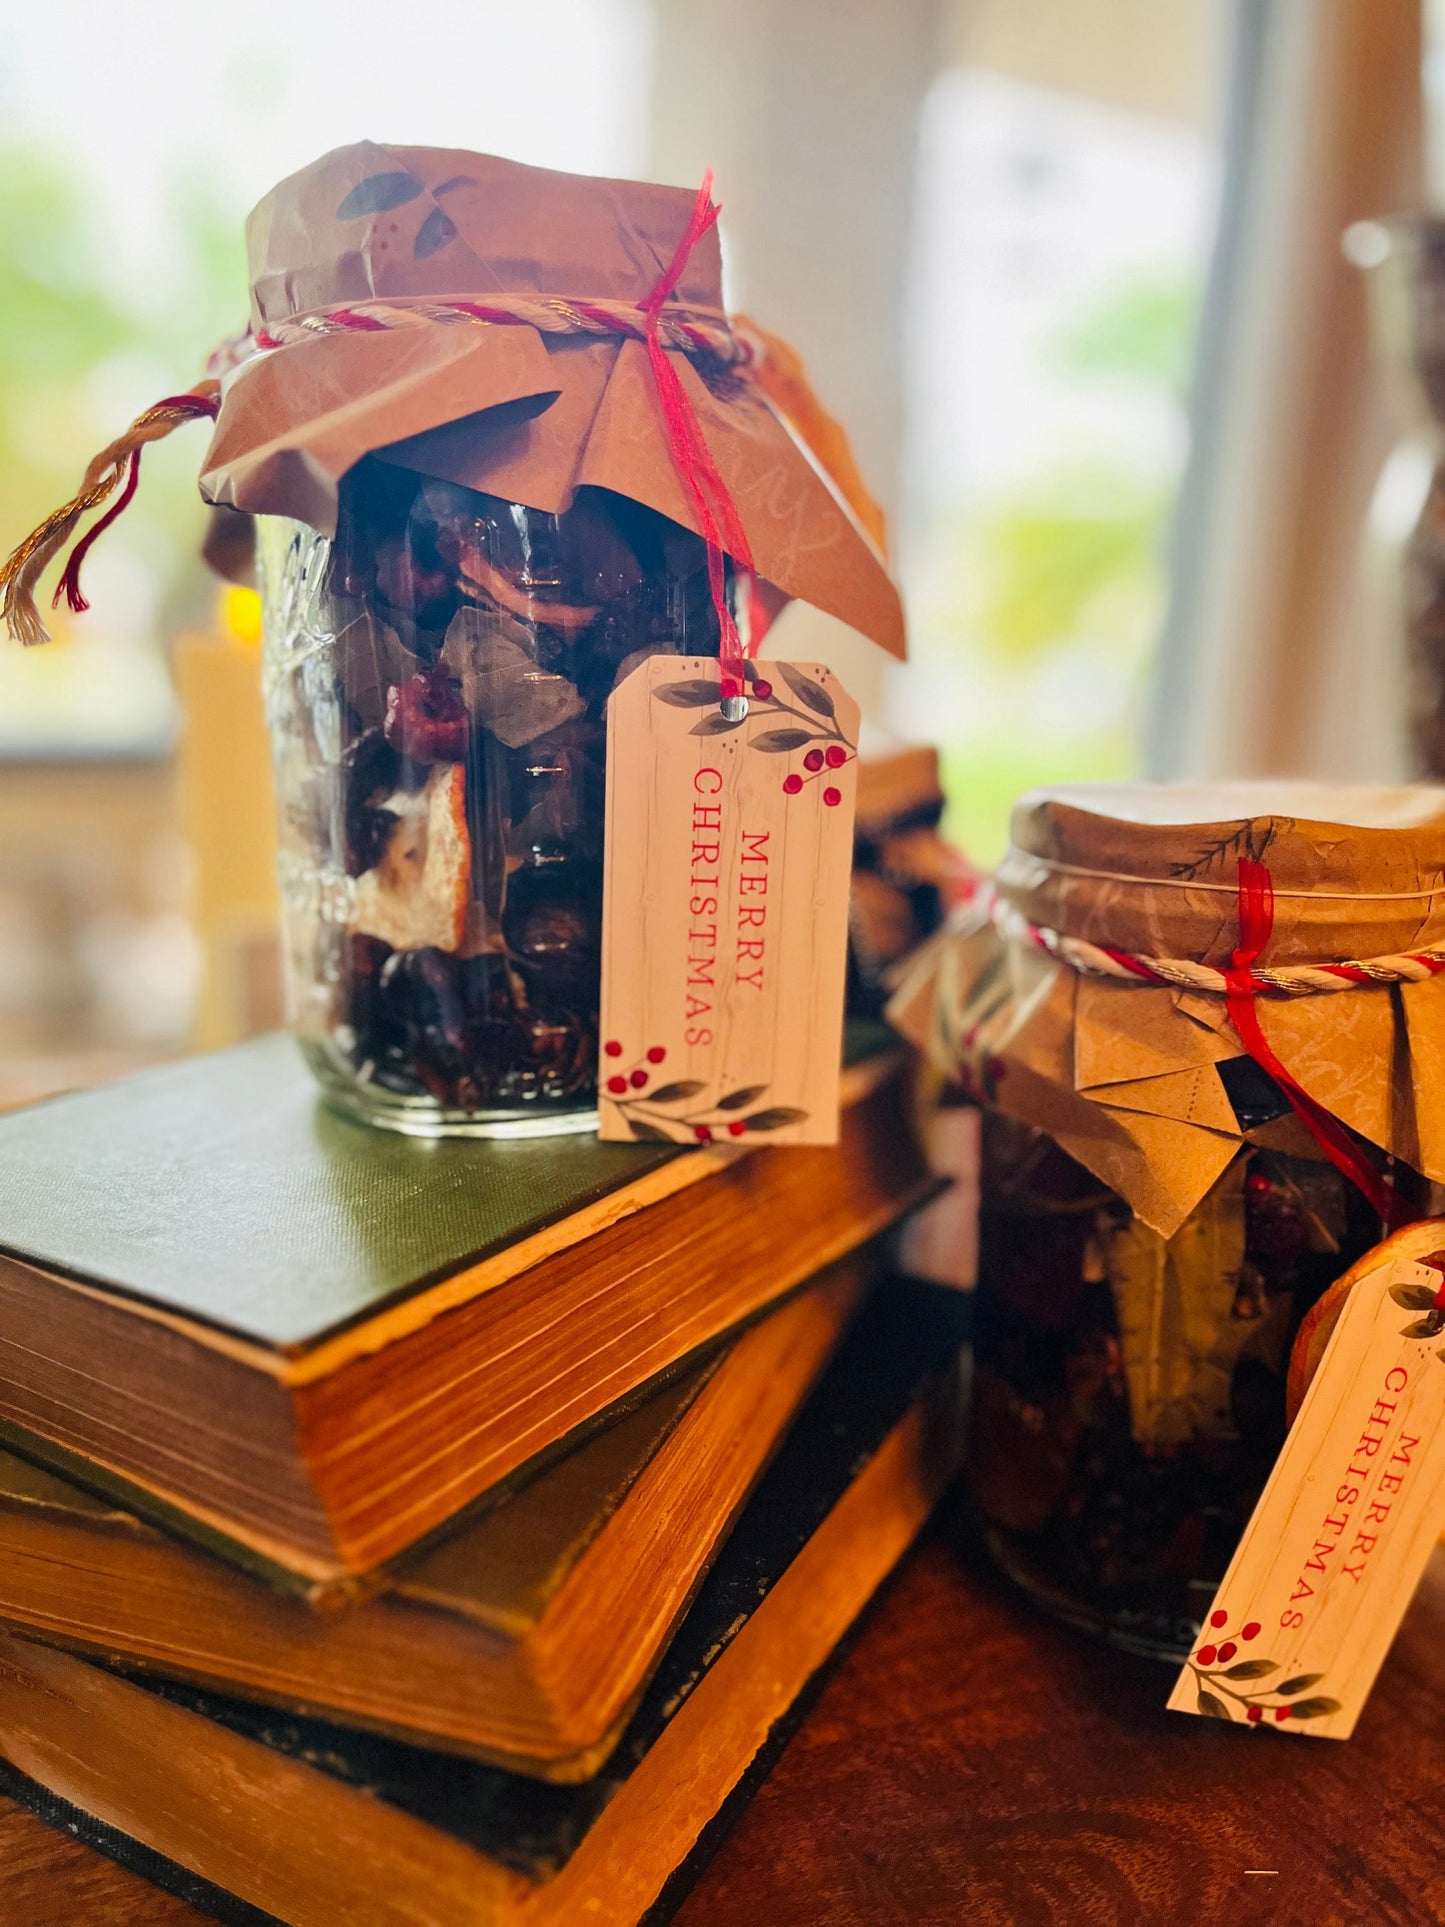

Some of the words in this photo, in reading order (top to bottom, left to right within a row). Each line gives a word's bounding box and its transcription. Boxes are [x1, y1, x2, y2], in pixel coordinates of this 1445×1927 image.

[684, 767, 723, 1047] CHRISTMAS
[734, 831, 770, 991] MERRY
[1279, 1366, 1408, 1630] CHRISTMAS
[1341, 1432, 1420, 1584] MERRY
